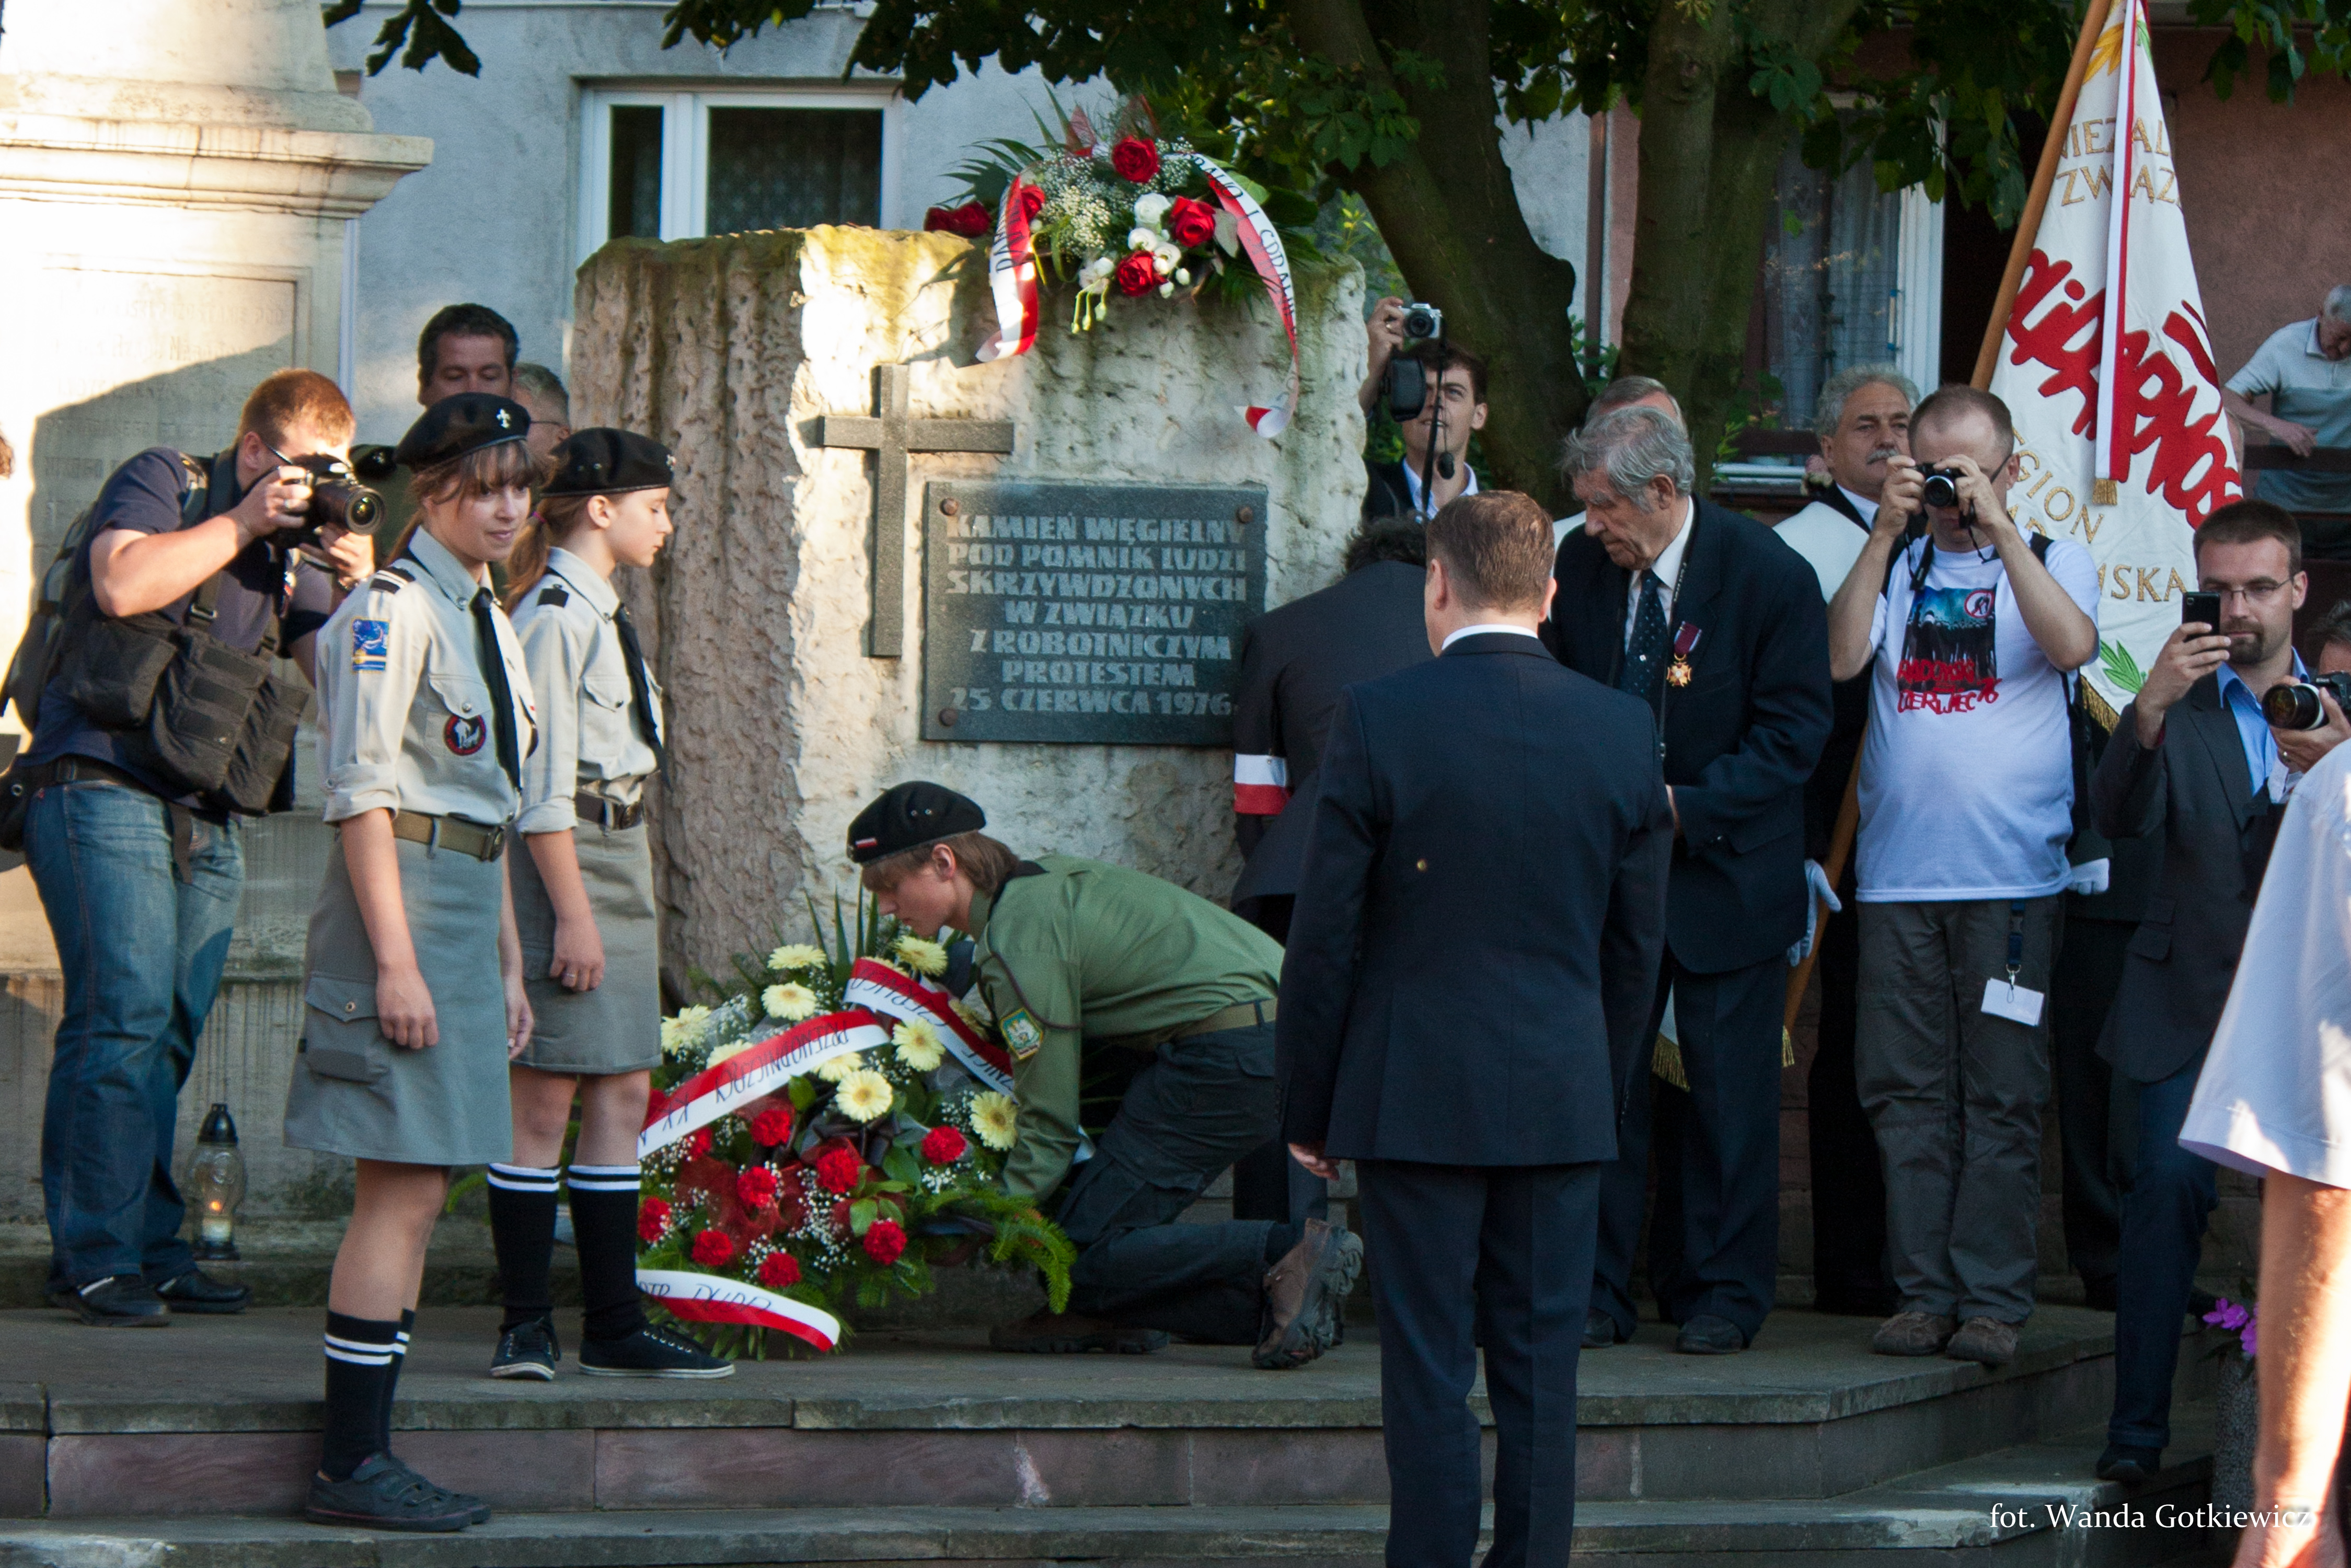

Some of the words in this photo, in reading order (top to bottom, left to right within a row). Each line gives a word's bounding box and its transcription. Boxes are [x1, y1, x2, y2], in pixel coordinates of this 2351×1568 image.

[1084, 516, 1246, 545] WĘGIELNY
[946, 543, 1014, 567] POD
[1021, 544, 1153, 570] POMNIK
[1161, 548, 1246, 571] LUDZI
[945, 570, 1246, 601] SKRZYWDZONYCH
[1005, 601, 1035, 624] W
[1044, 603, 1194, 629] ZWIĄZKU
[970, 629, 987, 652] Z
[993, 631, 1231, 660] ROBOTNICZYM
[1001, 660, 1196, 686] PROTESTEM
[950, 687, 991, 711] 25
[1000, 688, 1151, 714] CZERWCA
